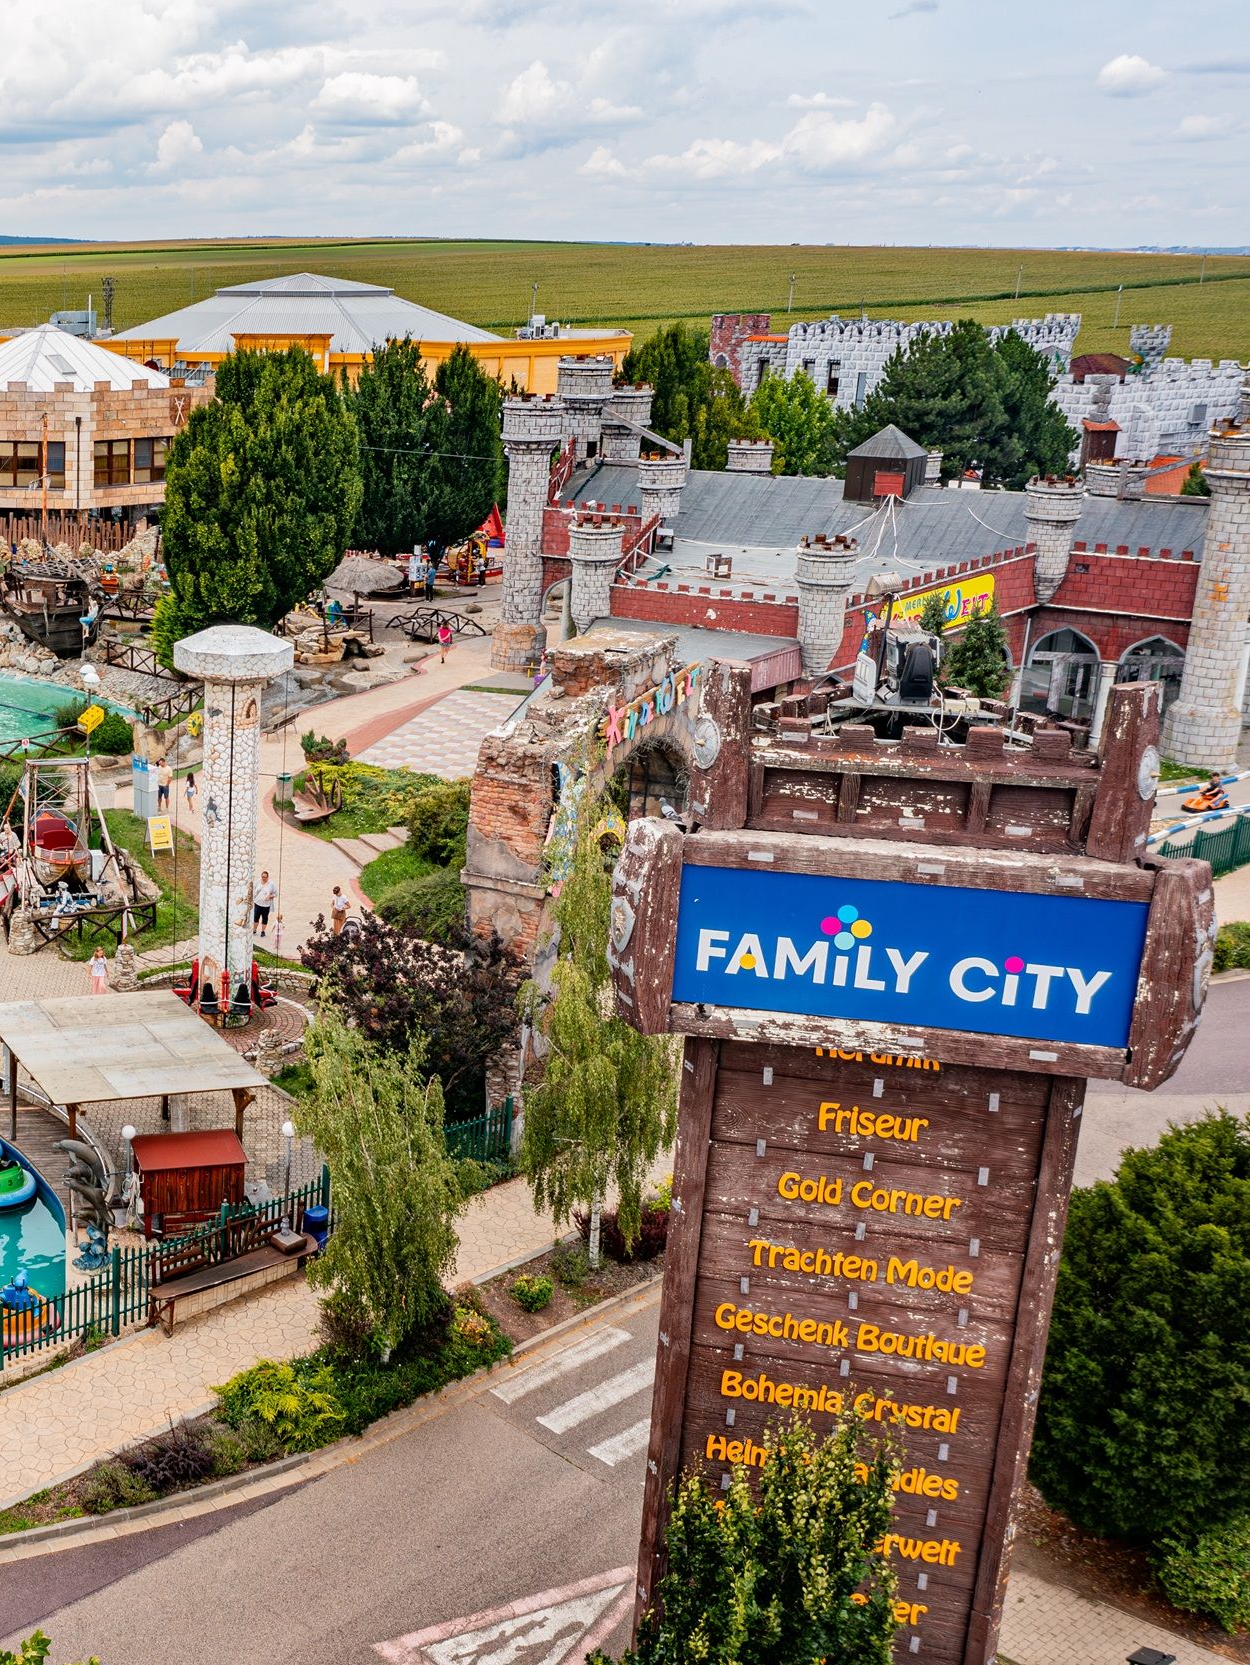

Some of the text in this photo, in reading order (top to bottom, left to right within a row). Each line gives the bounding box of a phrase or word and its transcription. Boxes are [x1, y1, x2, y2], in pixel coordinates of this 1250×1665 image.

[817, 1102, 929, 1142] Friseur
[777, 1172, 962, 1221] Gold Corner
[748, 1239, 975, 1295] Trachten Mode
[714, 1302, 987, 1368] Geschenk Boutique
[720, 1369, 844, 1415] Bohemia
